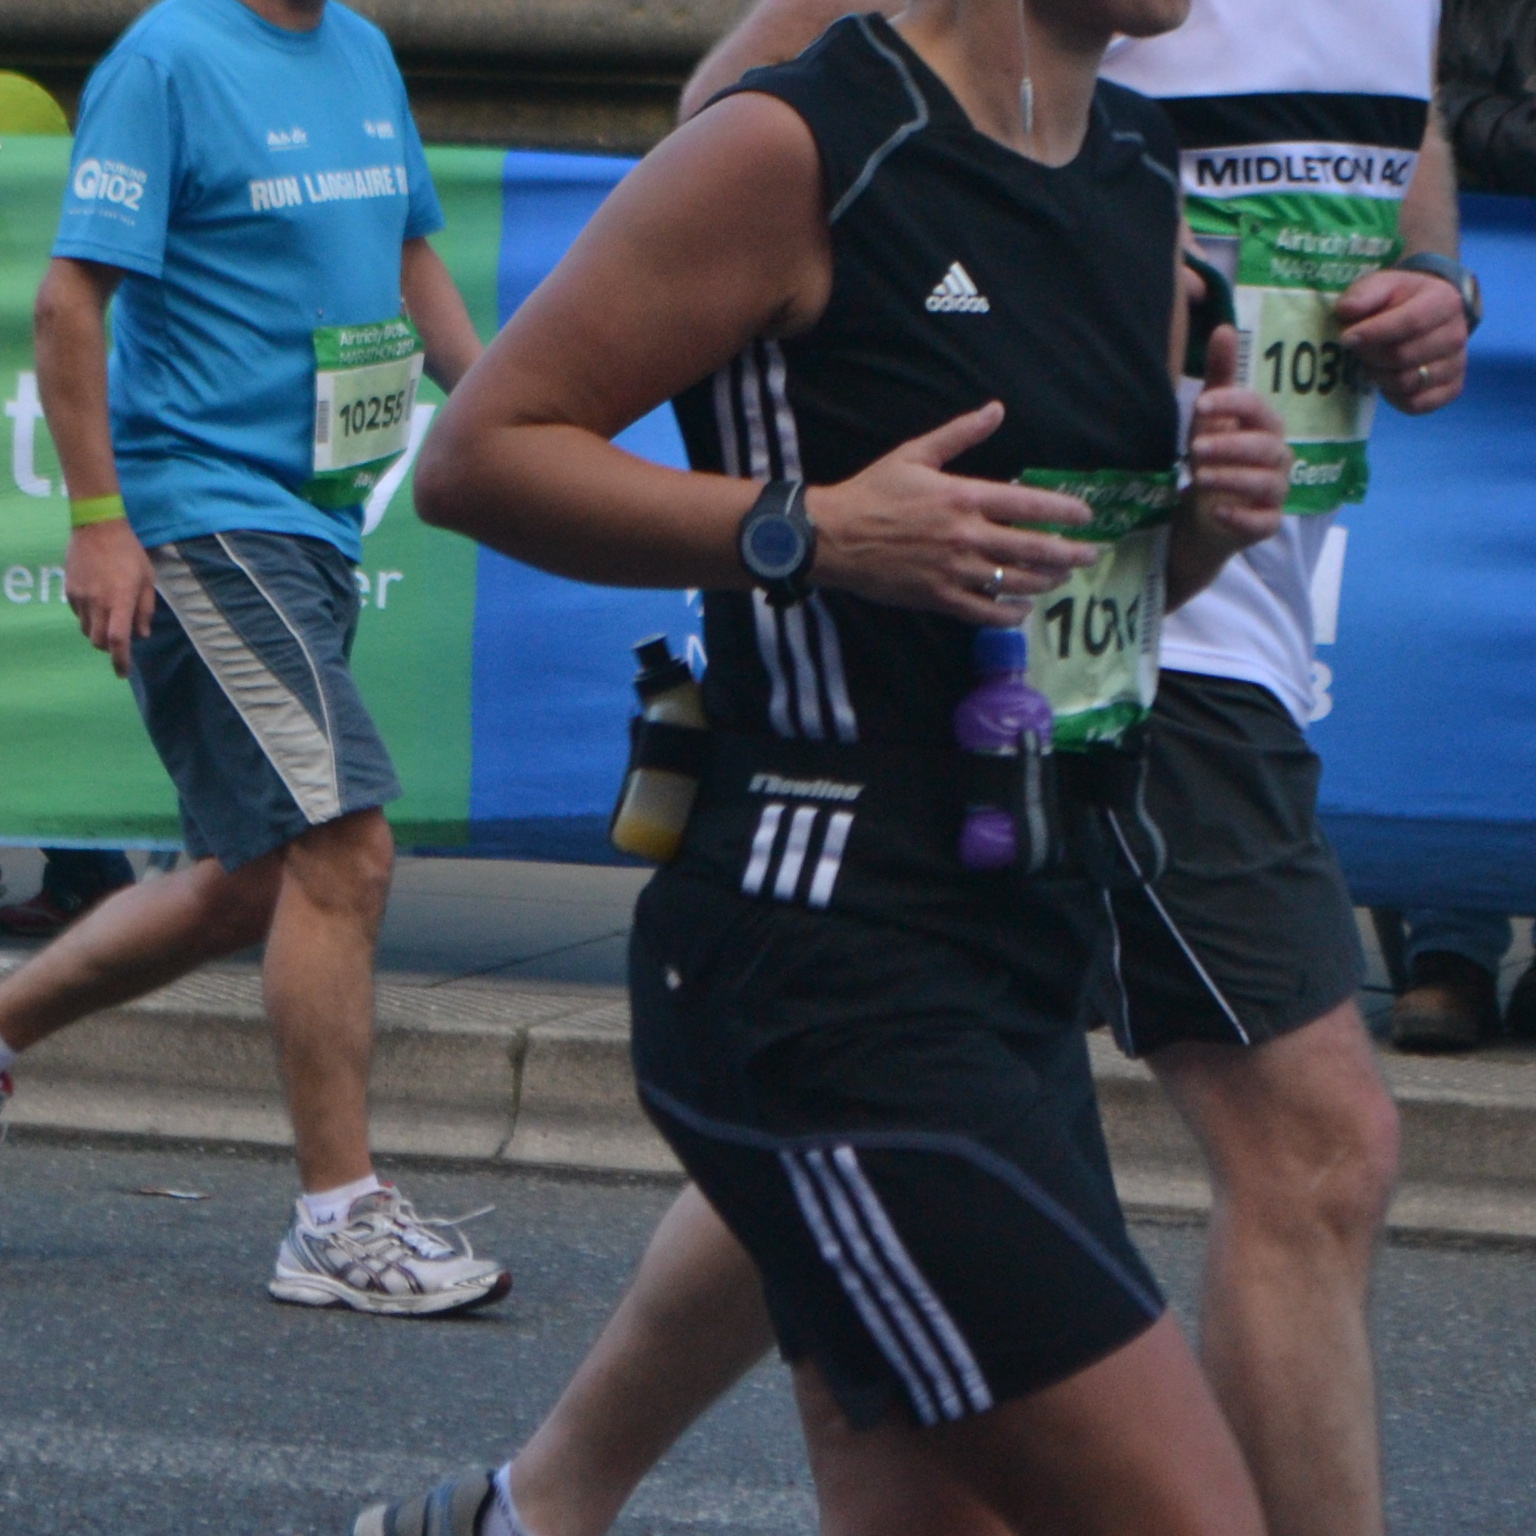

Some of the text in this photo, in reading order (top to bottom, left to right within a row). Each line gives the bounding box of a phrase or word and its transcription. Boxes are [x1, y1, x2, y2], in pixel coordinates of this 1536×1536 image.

[74, 157, 143, 212] Q102
[1197, 156, 1371, 185] MIDLETON
[250, 176, 303, 212] RUN
[925, 293, 991, 314] adidas
[339, 391, 405, 438] 10255
